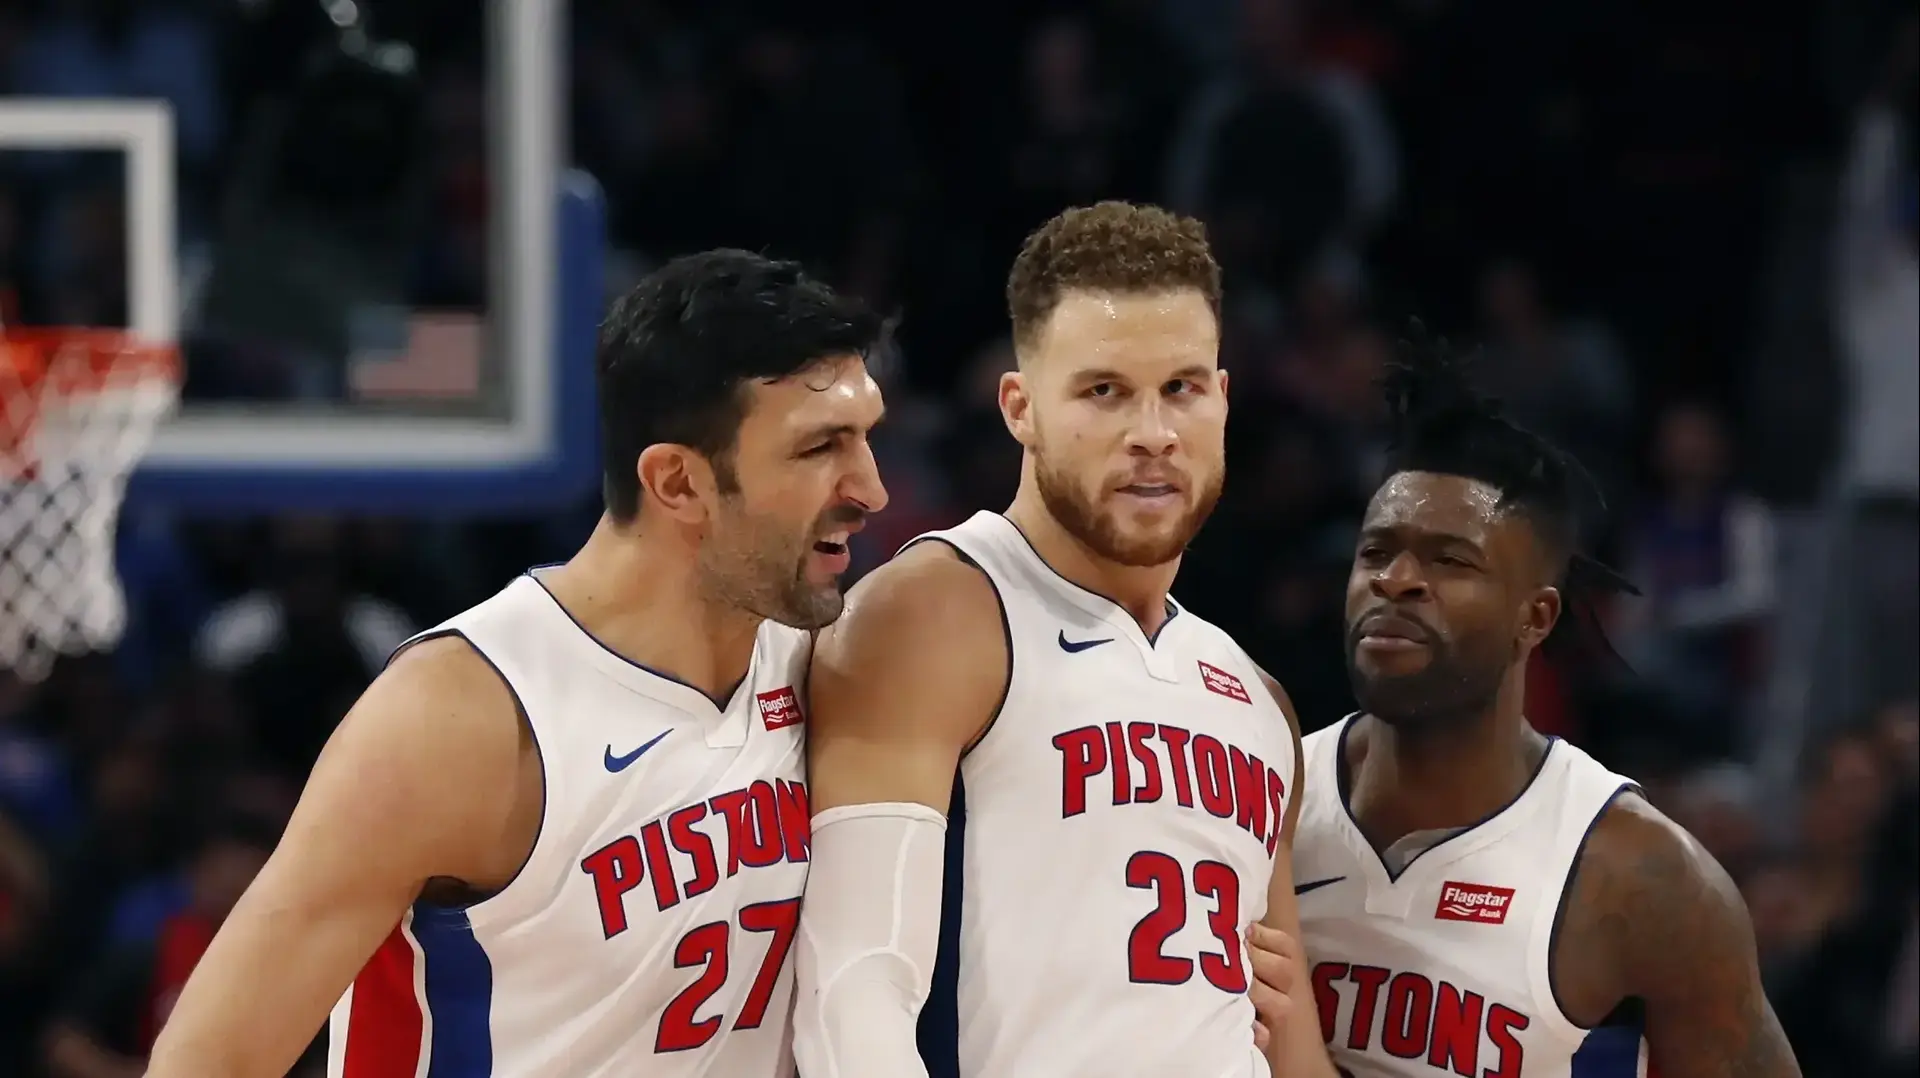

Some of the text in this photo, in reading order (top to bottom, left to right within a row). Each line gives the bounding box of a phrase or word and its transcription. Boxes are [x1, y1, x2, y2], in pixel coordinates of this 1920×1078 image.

[760, 694, 793, 713] Flagstar
[1052, 721, 1285, 859] PISTONS
[1126, 850, 1247, 993] 23
[1444, 887, 1508, 906] Flagstar
[1479, 908, 1501, 919] Bank
[653, 896, 804, 1054] 27
